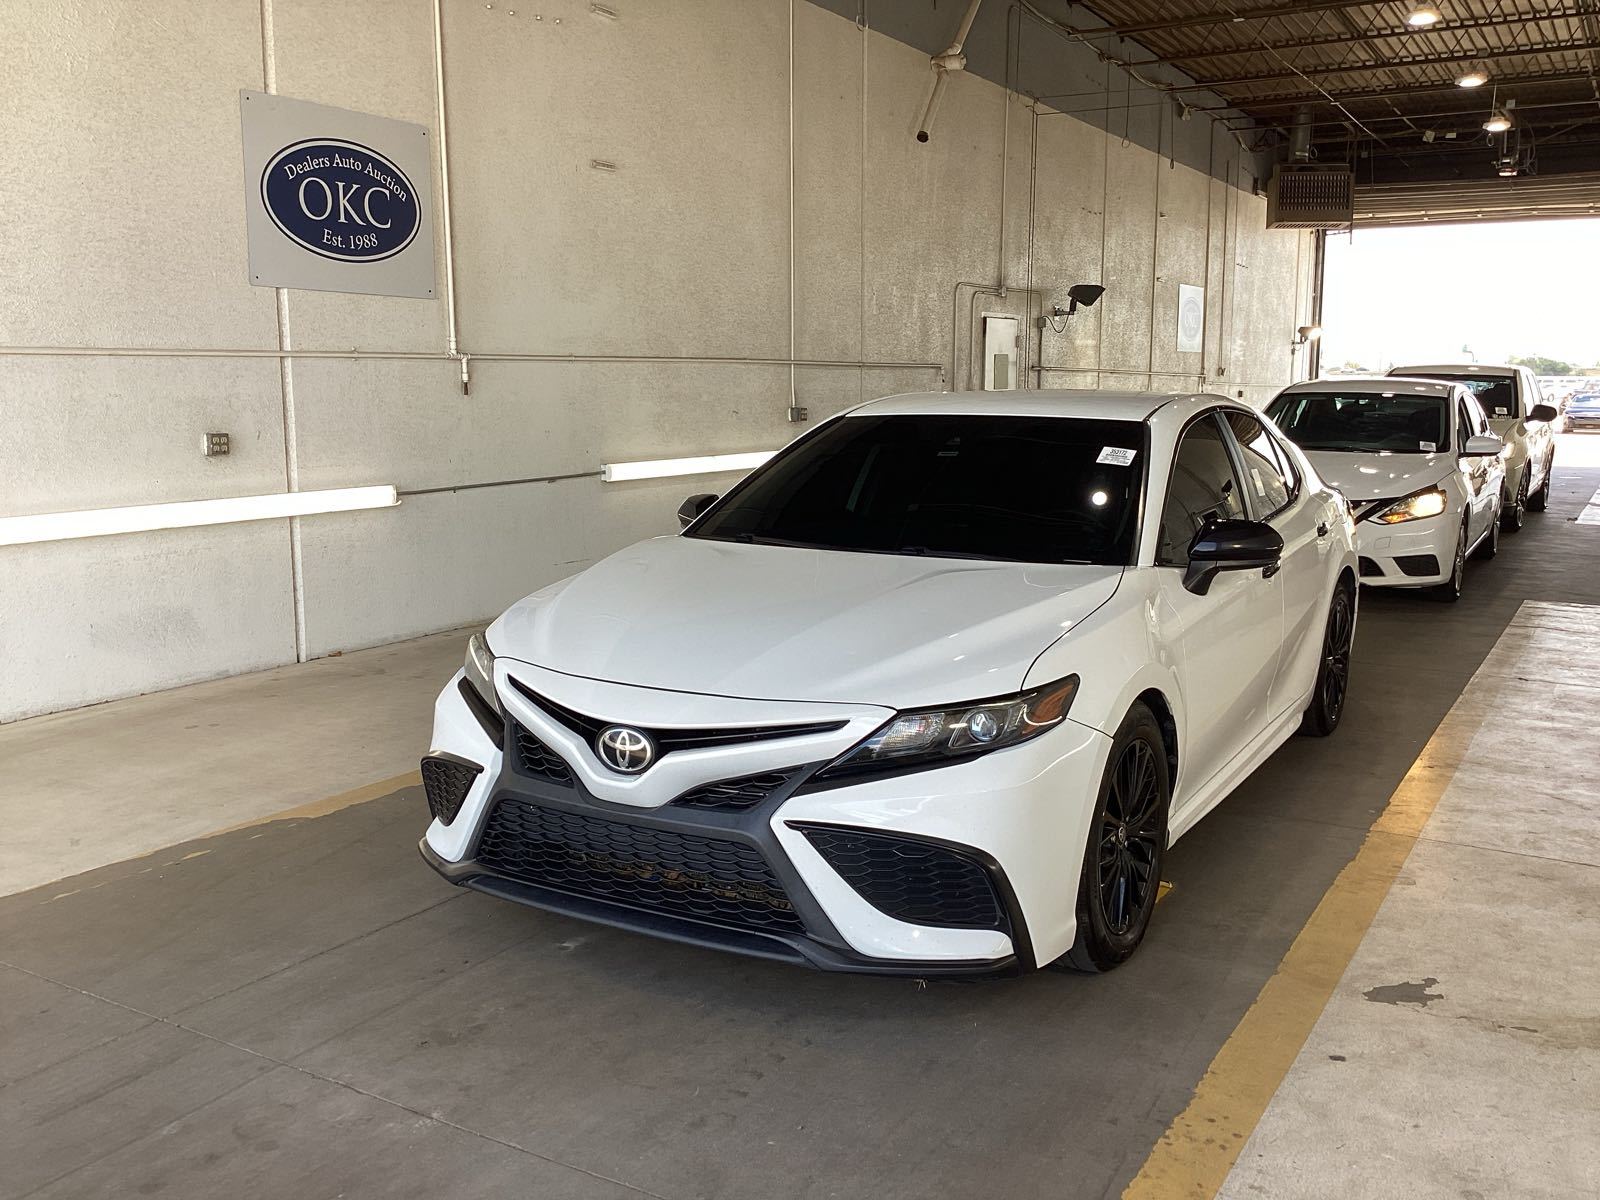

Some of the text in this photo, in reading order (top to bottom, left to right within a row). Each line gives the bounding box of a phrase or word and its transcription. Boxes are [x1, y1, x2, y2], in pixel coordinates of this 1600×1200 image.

[284, 153, 407, 202] Dealers Auto Auction
[298, 177, 392, 229] OKC
[322, 228, 378, 250] Est. 1988
